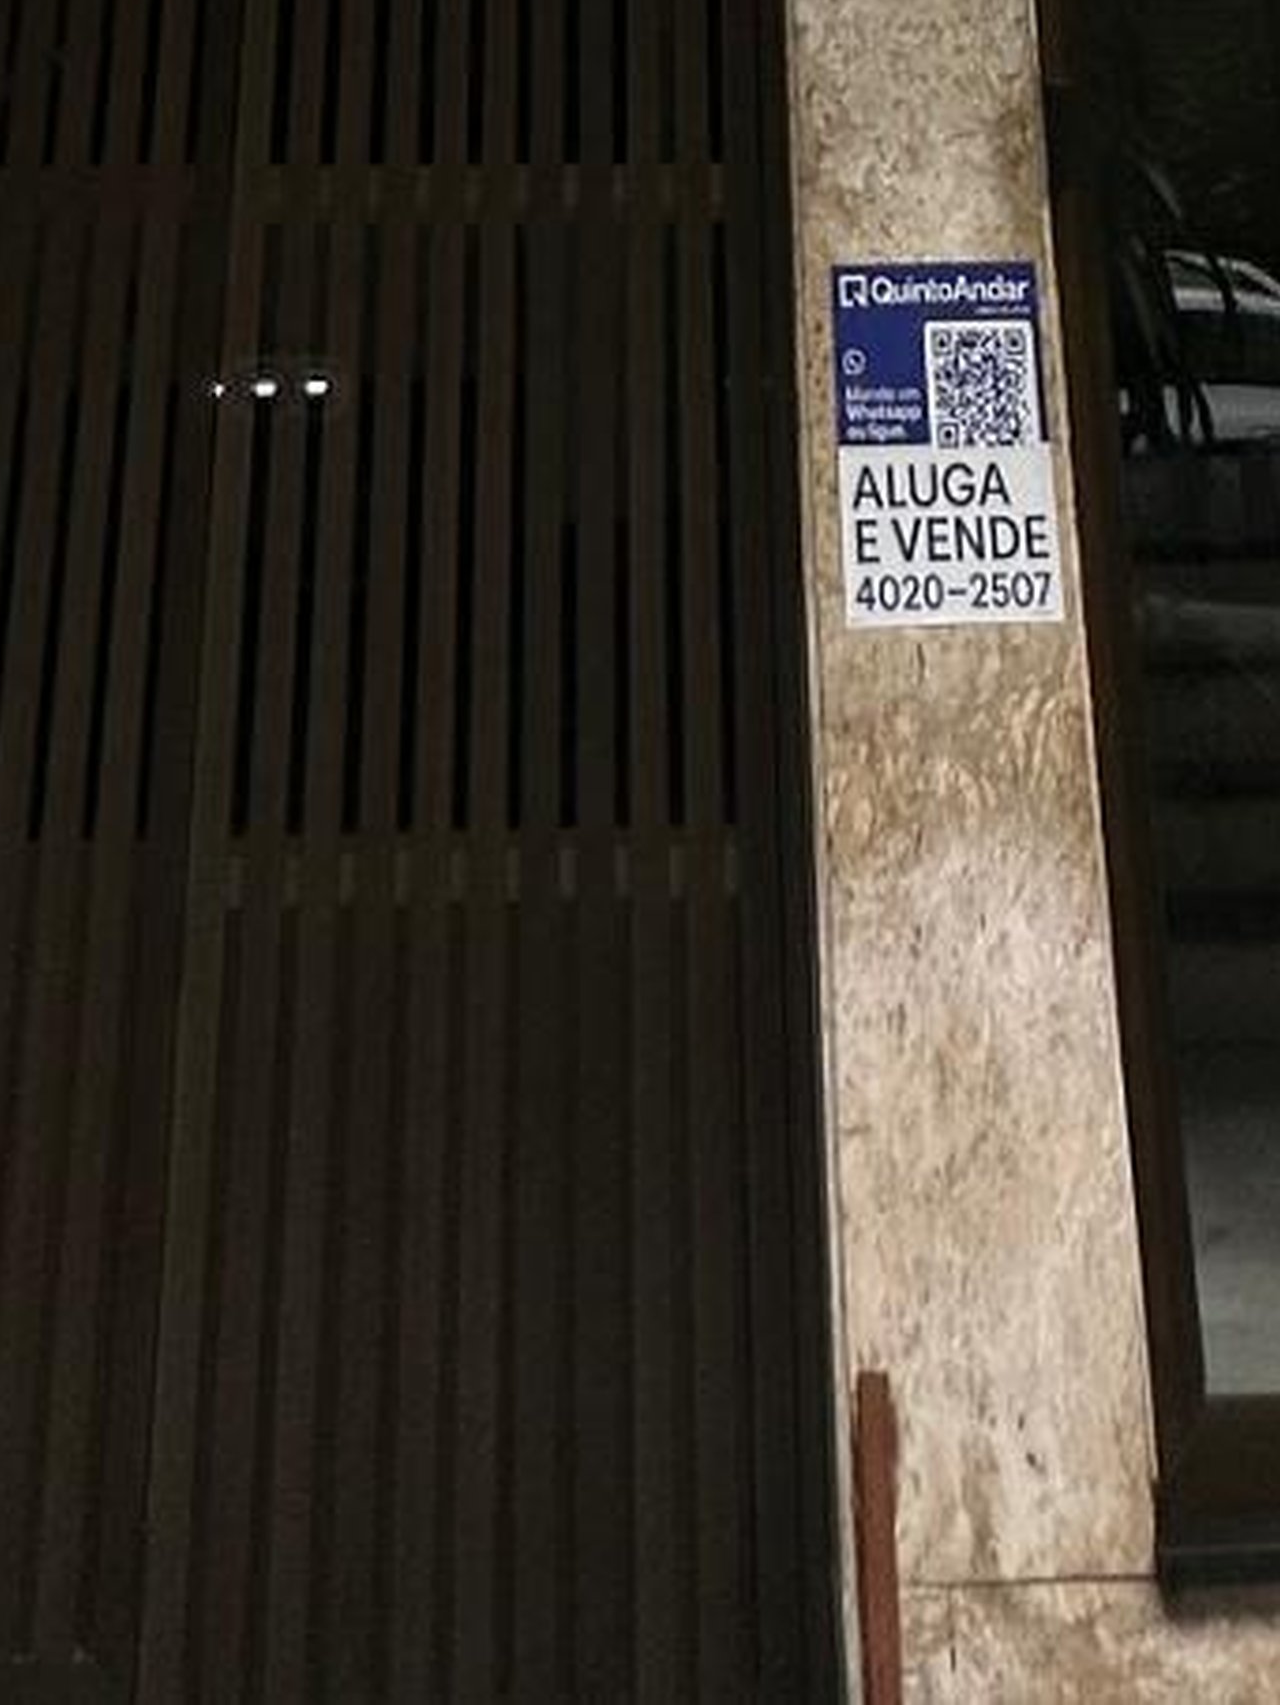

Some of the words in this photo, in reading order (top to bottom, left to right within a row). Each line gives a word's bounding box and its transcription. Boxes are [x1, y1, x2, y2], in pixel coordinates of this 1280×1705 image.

[871, 273, 1031, 305] QuintoAndar
[852, 461, 1012, 511] ALUGA
[855, 518, 881, 564] E
[890, 514, 1051, 563] VENDE
[855, 570, 1052, 612] 4020-2507
